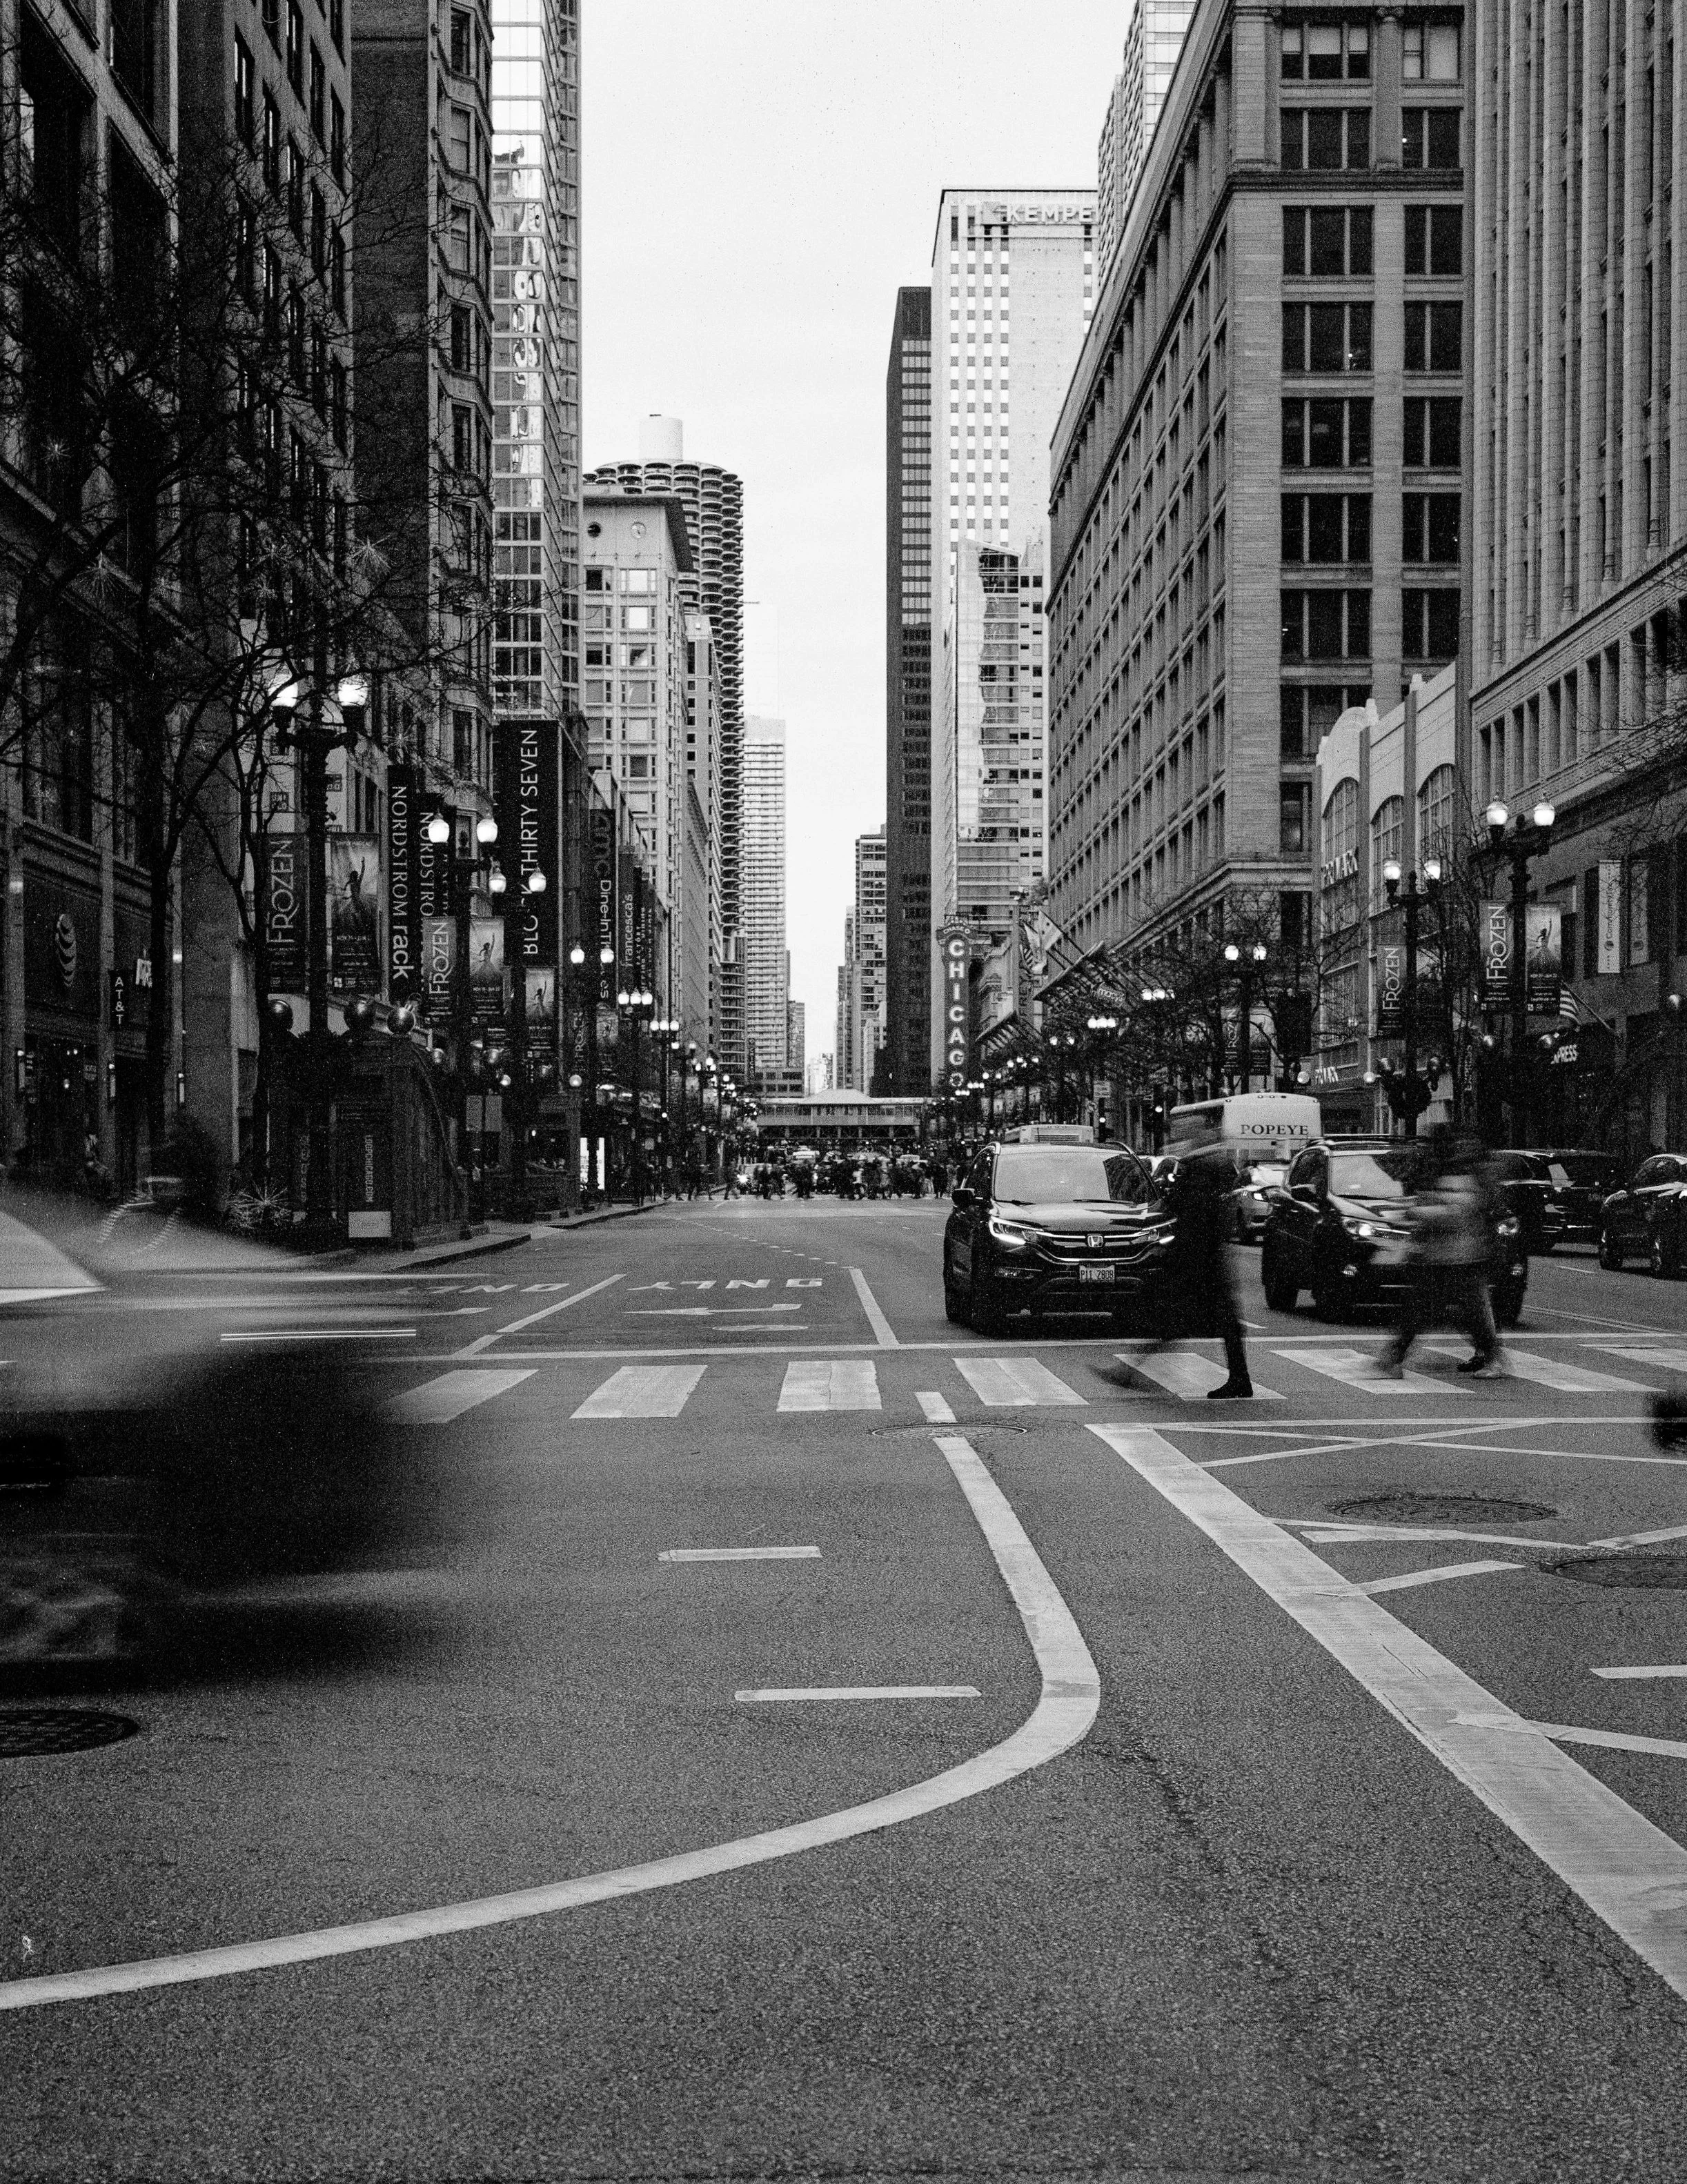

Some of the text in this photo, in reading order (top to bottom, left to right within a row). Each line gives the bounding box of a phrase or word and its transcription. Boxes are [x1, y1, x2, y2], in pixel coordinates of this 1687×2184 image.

[1006, 205, 1098, 222] KEMPE
[520, 729, 538, 954] BLOK THIRTY SEVEN
[266, 840, 299, 943] FROZEN
[392, 786, 414, 980] NORDSTROM rack
[428, 922, 453, 994] FROZEN
[621, 894, 633, 966] francesca's
[1486, 906, 1511, 980] FROZEN
[115, 976, 125, 1025] AT&T
[949, 939, 965, 1087] CHICAGO
[1383, 948, 1403, 1010] FROZEN
[1241, 1124, 1309, 1135] POPEYE
[364, 1134, 374, 1202] LOOPCHICAGO.COM
[627, 1278, 823, 1291] ONLY
